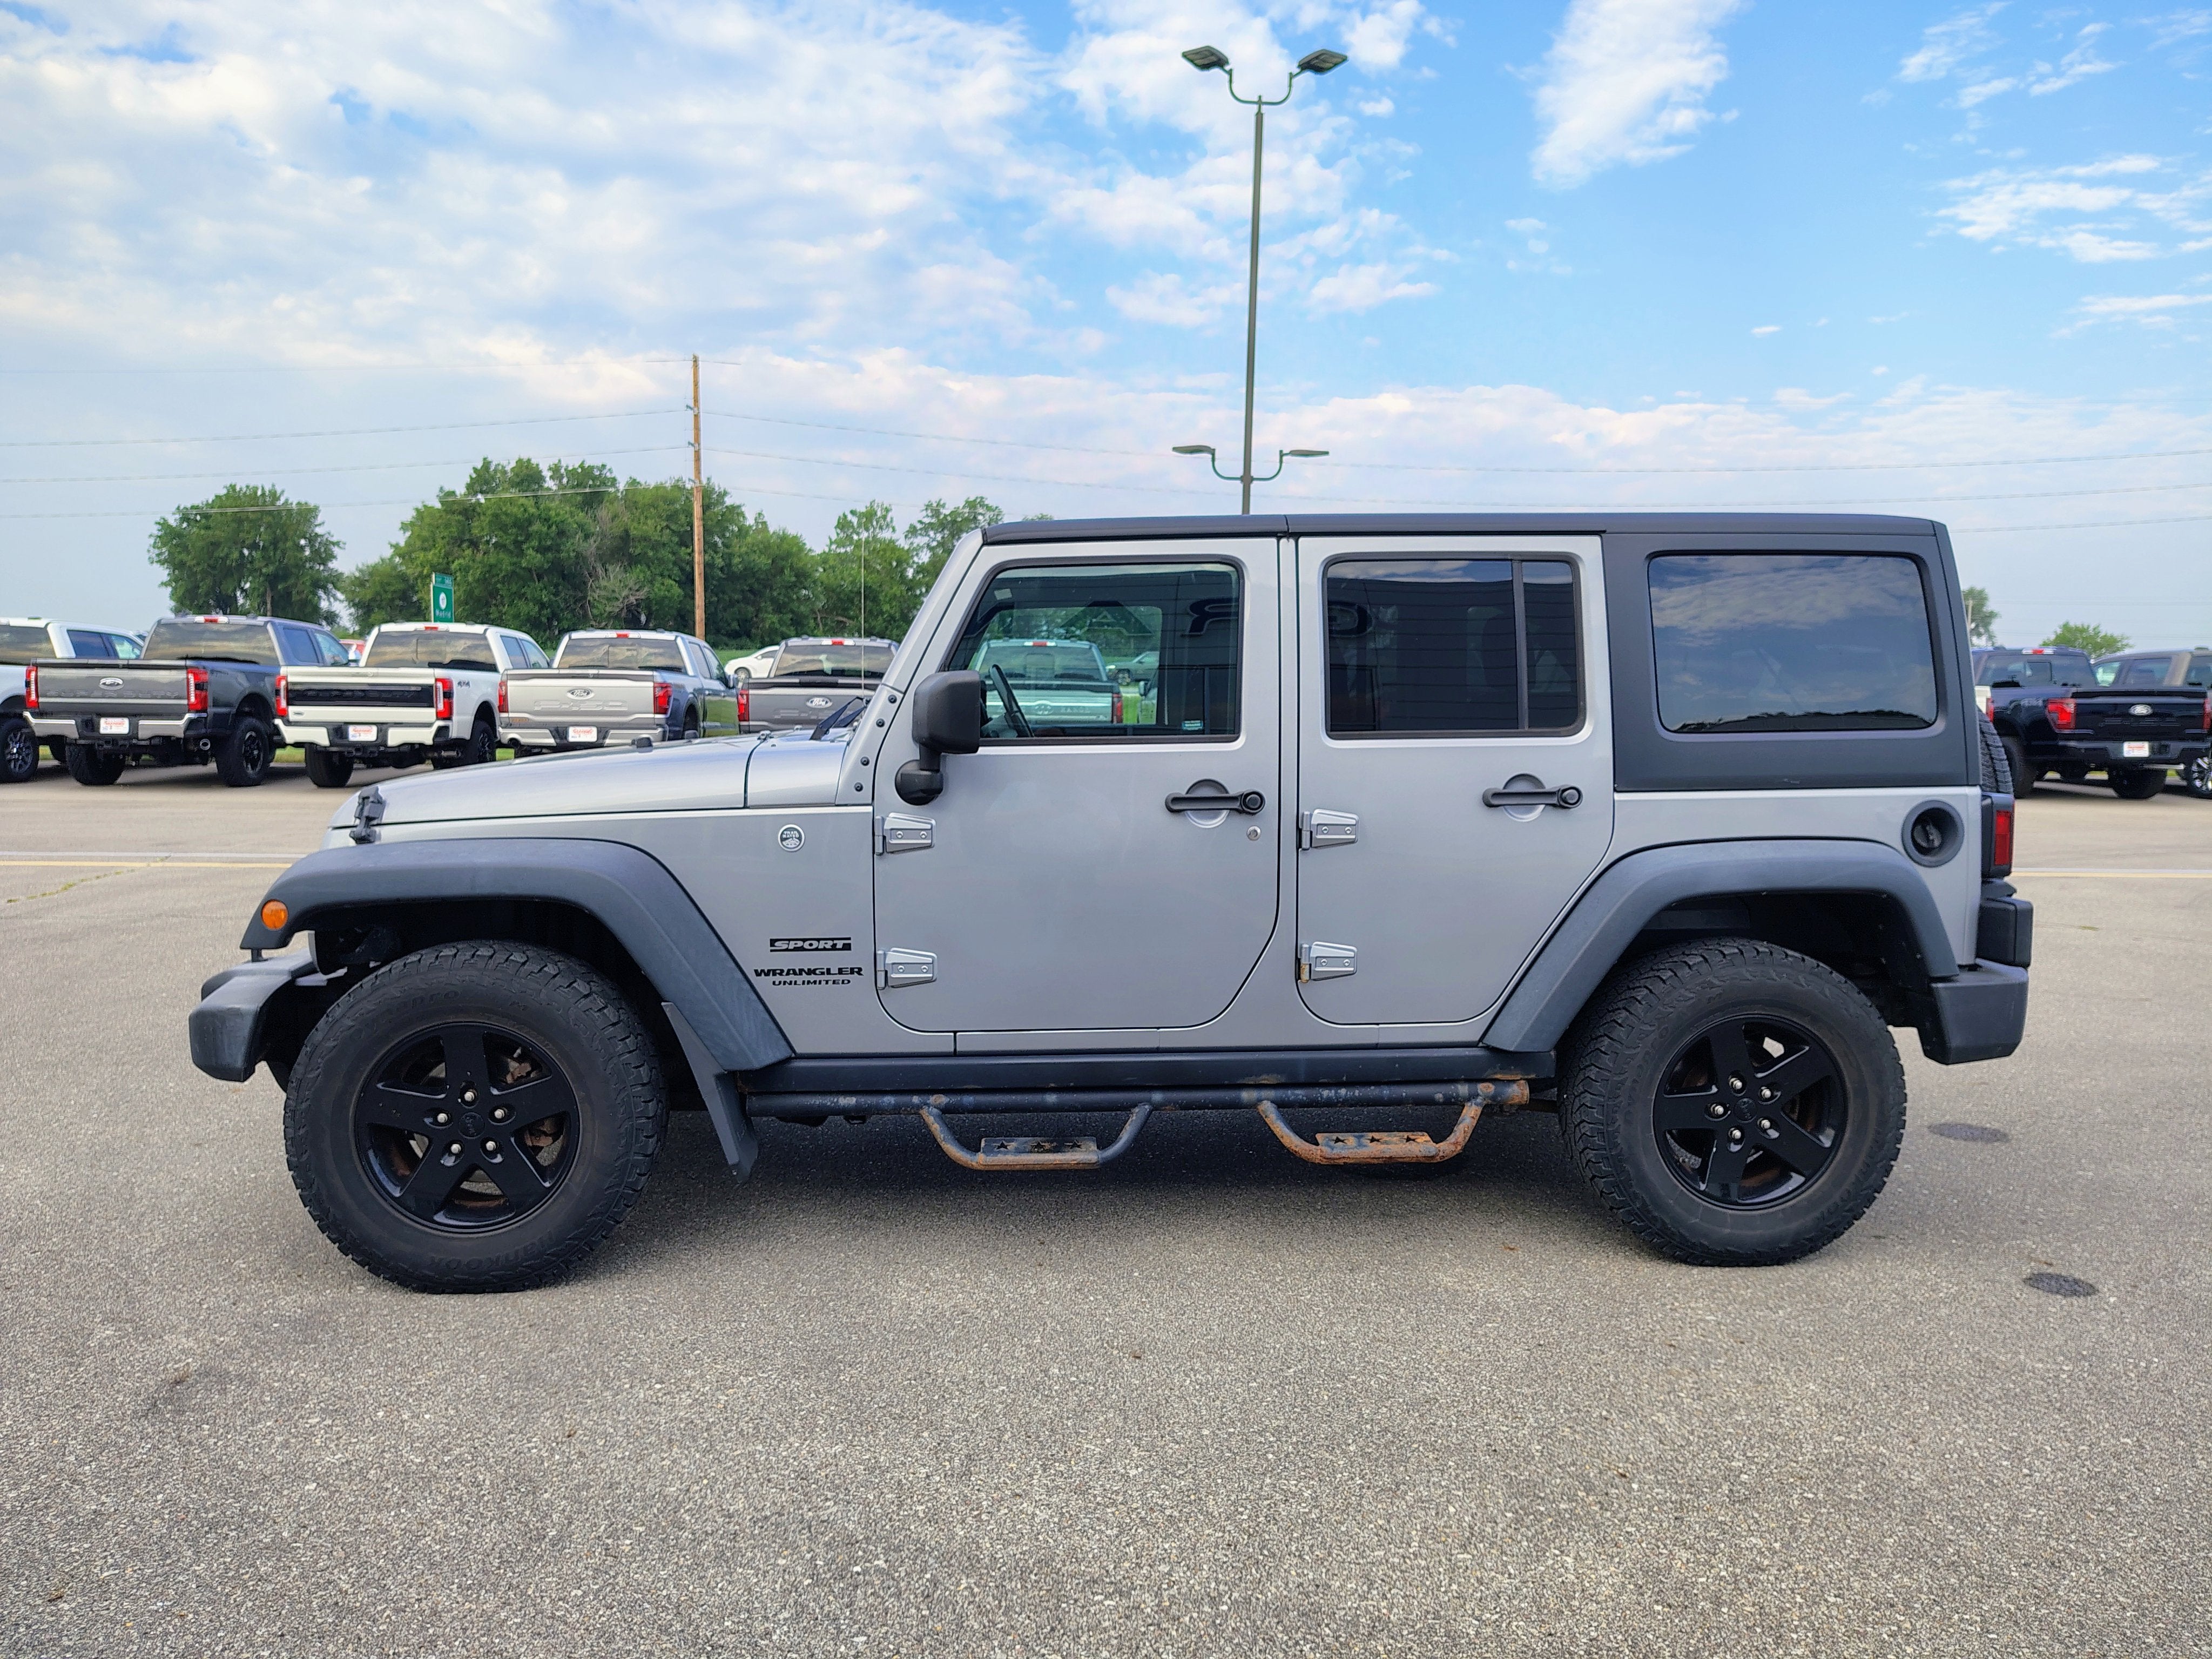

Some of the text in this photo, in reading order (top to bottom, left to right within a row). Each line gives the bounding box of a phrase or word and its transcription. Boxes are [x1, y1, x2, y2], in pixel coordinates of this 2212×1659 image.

[46, 689, 179, 698] SUPER DUTY
[533, 699, 628, 711] F-150
[770, 939, 851, 950] SPORT
[754, 967, 864, 977] WRANGLER
